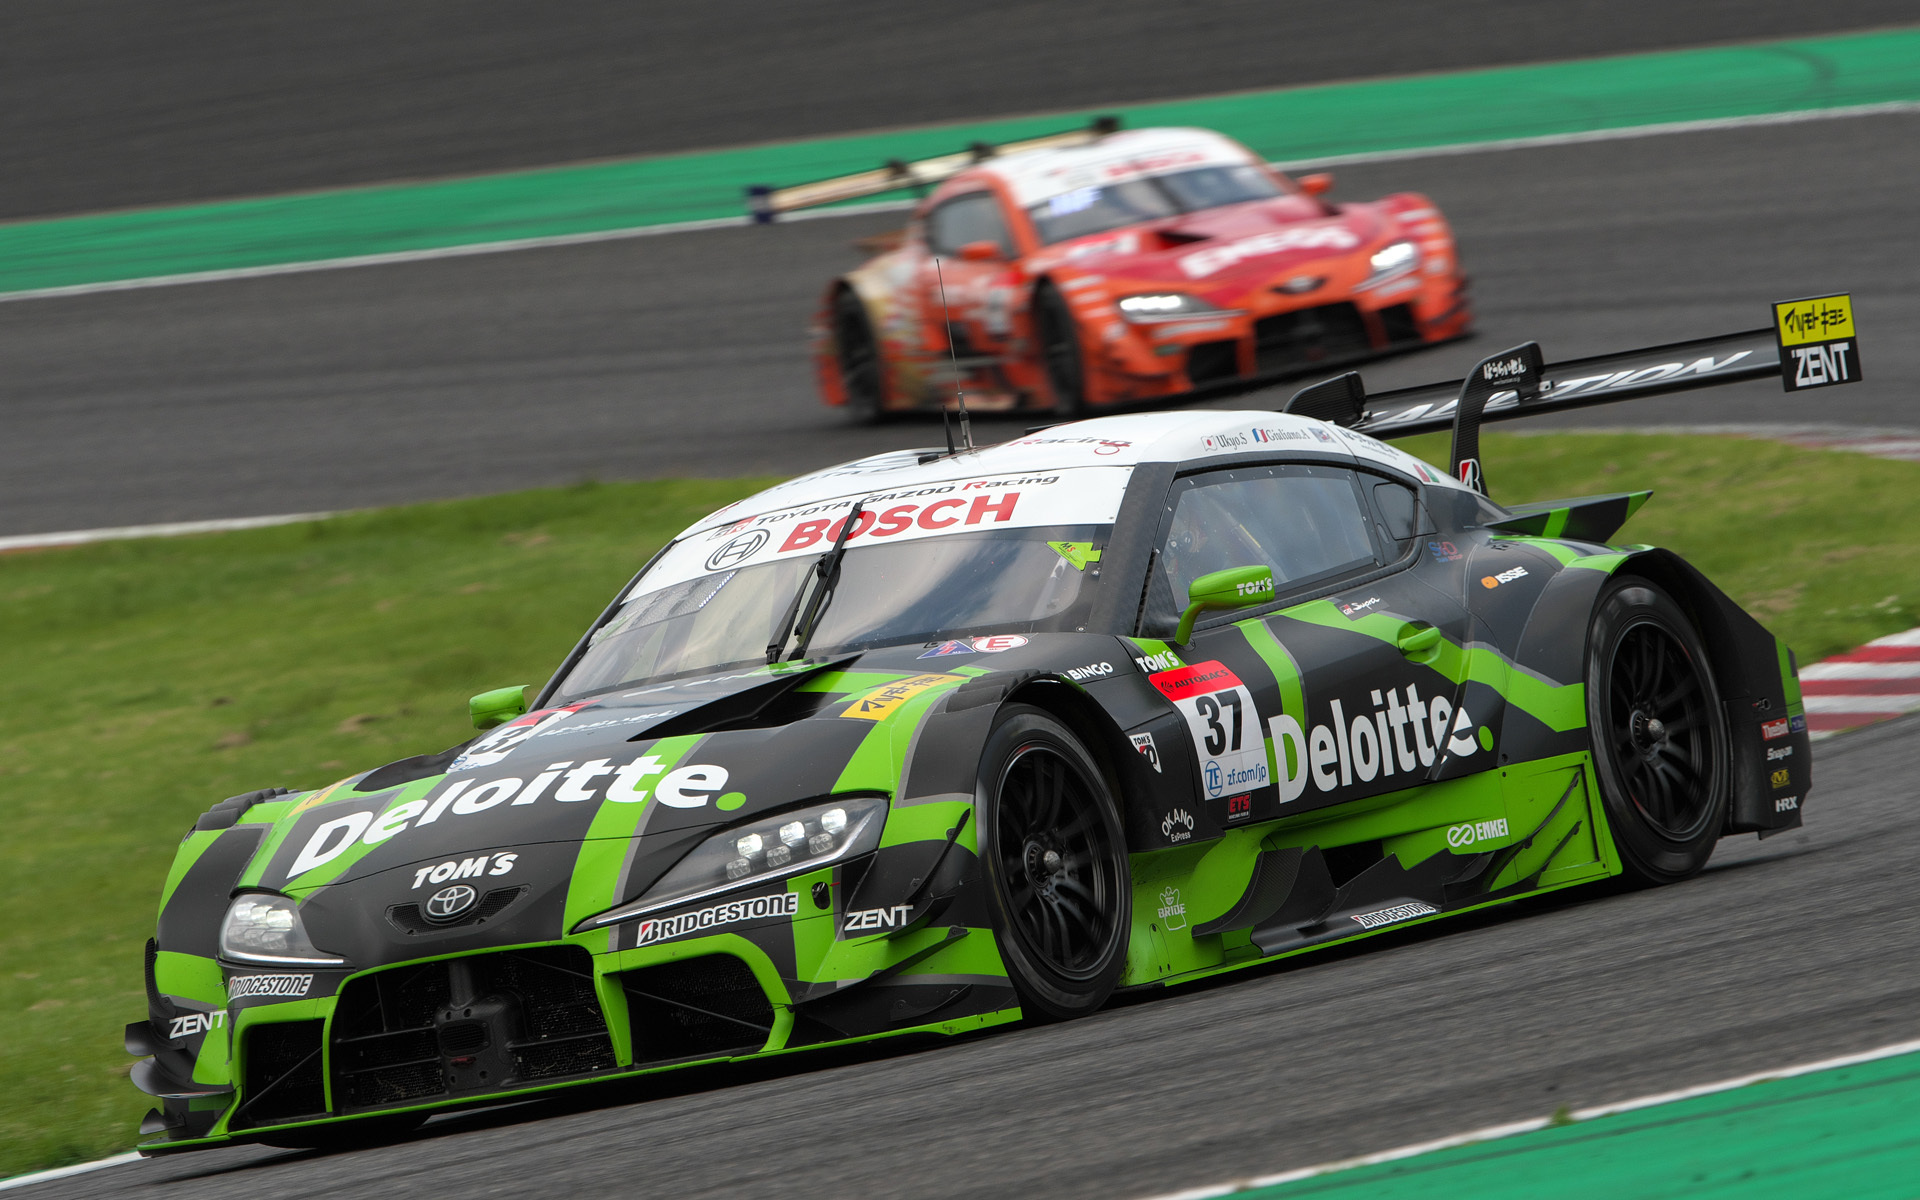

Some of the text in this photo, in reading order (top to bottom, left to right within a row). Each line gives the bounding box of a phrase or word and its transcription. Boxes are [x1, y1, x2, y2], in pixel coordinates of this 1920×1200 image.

[1791, 342, 1849, 387] ZENT
[1216, 432, 1248, 450] Ukyo.S
[757, 475, 1060, 526] TOYOTA GAZOO Racing
[777, 492, 1021, 553] BOSCH
[1236, 577, 1273, 596] TOM'S
[1067, 661, 1114, 680] BINGO
[1135, 650, 1180, 672] TOM'S
[1174, 669, 1229, 689] AUTOBACS
[1196, 689, 1242, 756] 37
[1205, 763, 1267, 791] ZF zf.com/jp
[1229, 794, 1250, 813] ETS
[1776, 796, 1798, 812] HRX
[1162, 808, 1194, 837] OKANO
[1477, 818, 1509, 841] ENKEI
[412, 852, 519, 889] TOM'S
[637, 893, 798, 947] BRIDGESTONE
[845, 905, 913, 931] ZENT
[1158, 903, 1186, 918] BRIDE
[1351, 901, 1438, 929] BRIDGESTONE
[228, 974, 313, 1002] BRIDGESTONE
[169, 1010, 227, 1039] ZENT
